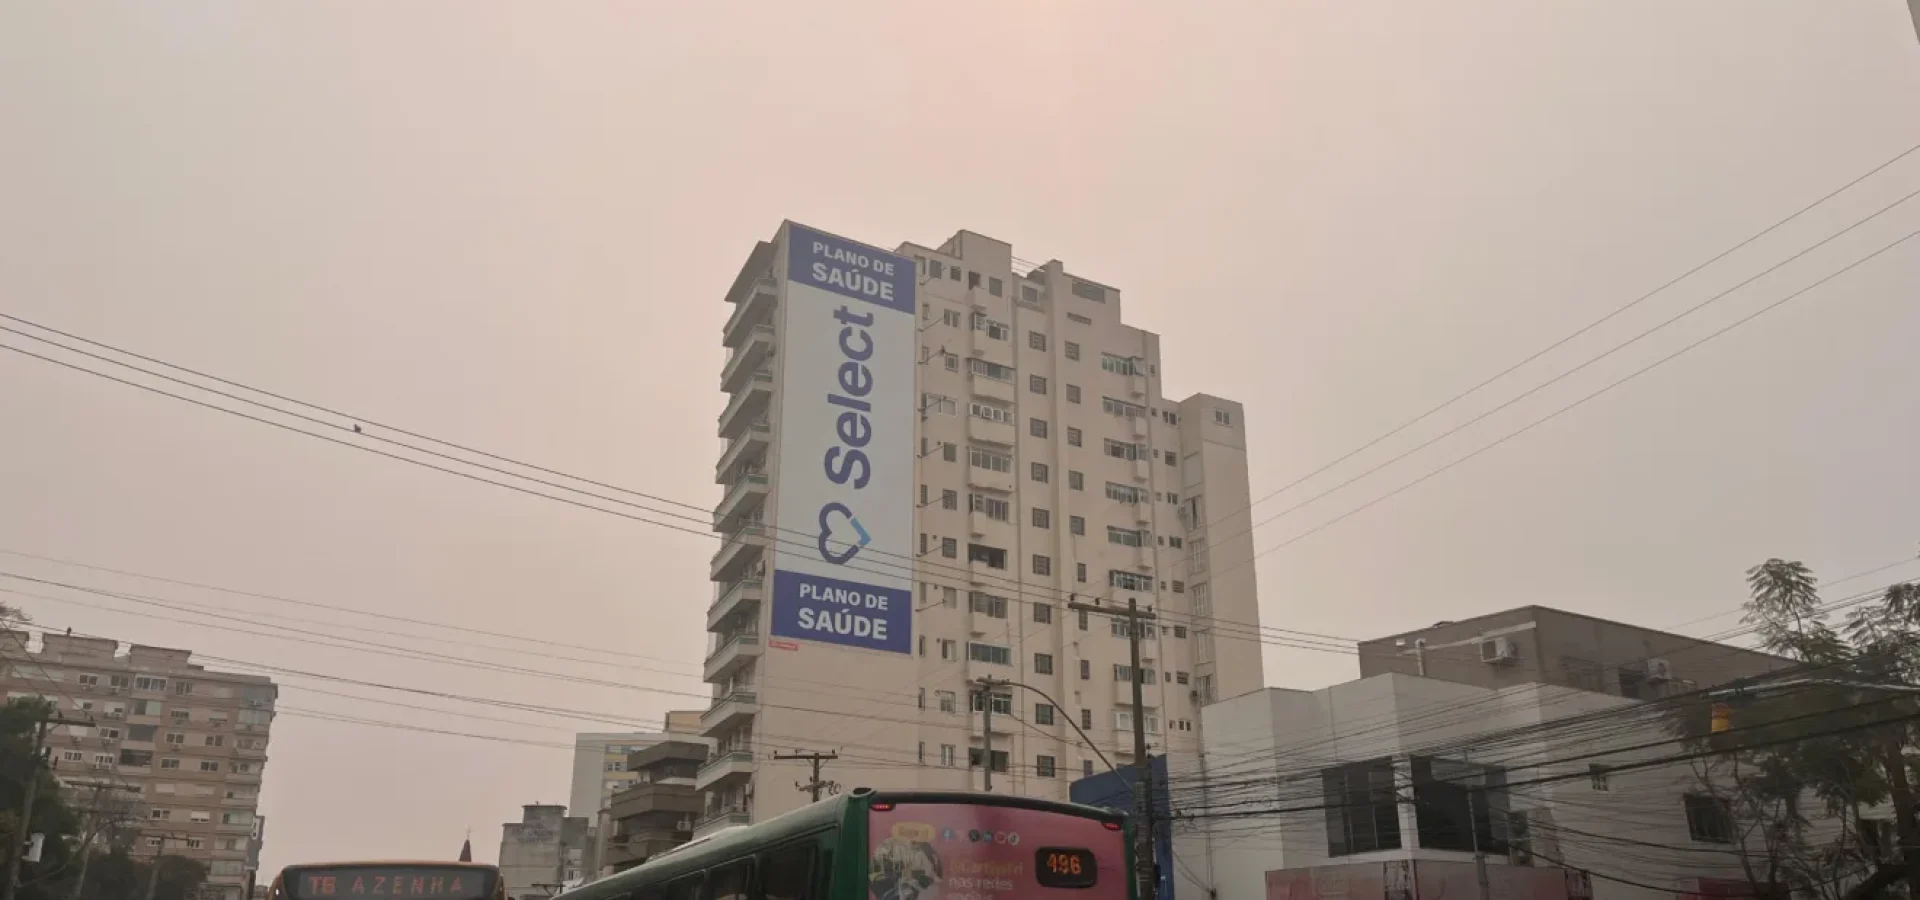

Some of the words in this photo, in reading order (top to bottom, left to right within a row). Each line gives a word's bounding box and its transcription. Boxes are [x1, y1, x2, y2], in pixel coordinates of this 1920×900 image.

[812, 241, 870, 269] PLANO
[873, 257, 895, 277] DE
[812, 262, 895, 301] SAÚDE
[824, 305, 874, 490] Select
[799, 583, 861, 606] PLANO
[865, 594, 889, 611] DE
[797, 607, 888, 640] SAÚDE
[1047, 853, 1082, 875] 496
[351, 876, 465, 894] AZENHA
